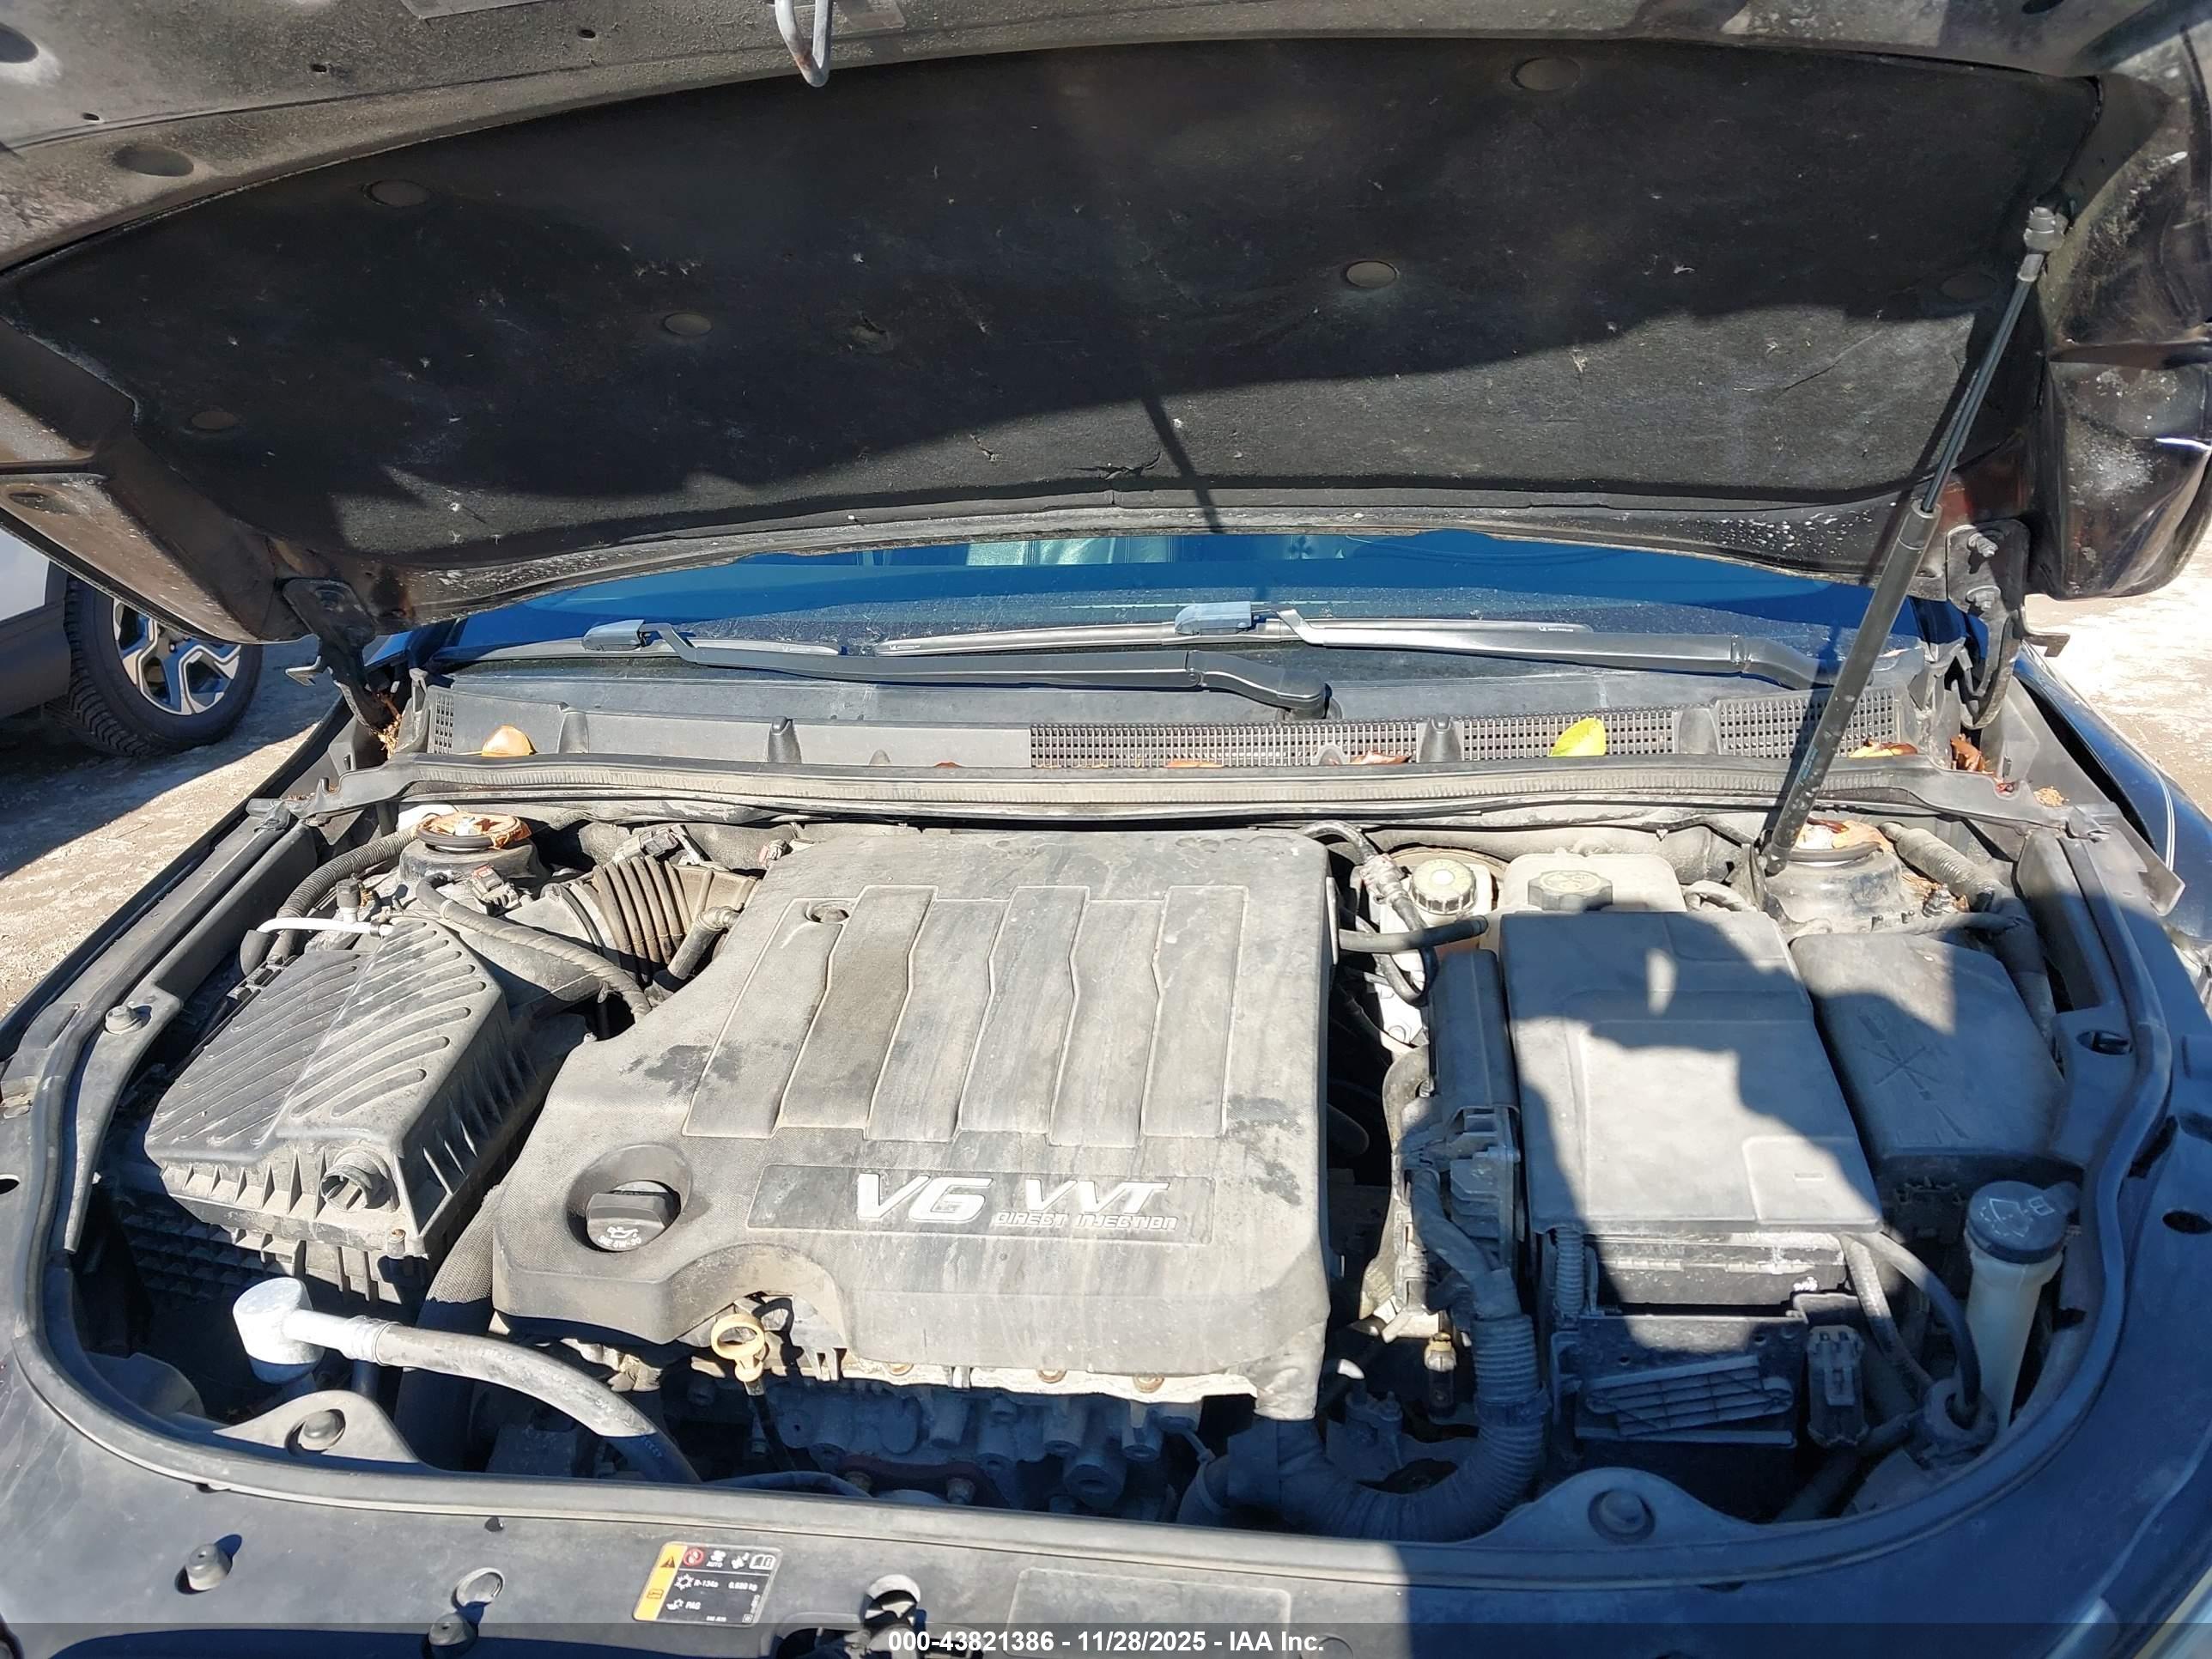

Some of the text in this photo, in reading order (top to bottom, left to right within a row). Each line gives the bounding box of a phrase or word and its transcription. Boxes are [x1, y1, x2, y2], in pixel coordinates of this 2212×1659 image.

[858, 1173, 1170, 1223] V6 VVT
[995, 1212, 1179, 1231] DIRECT INJECTION
